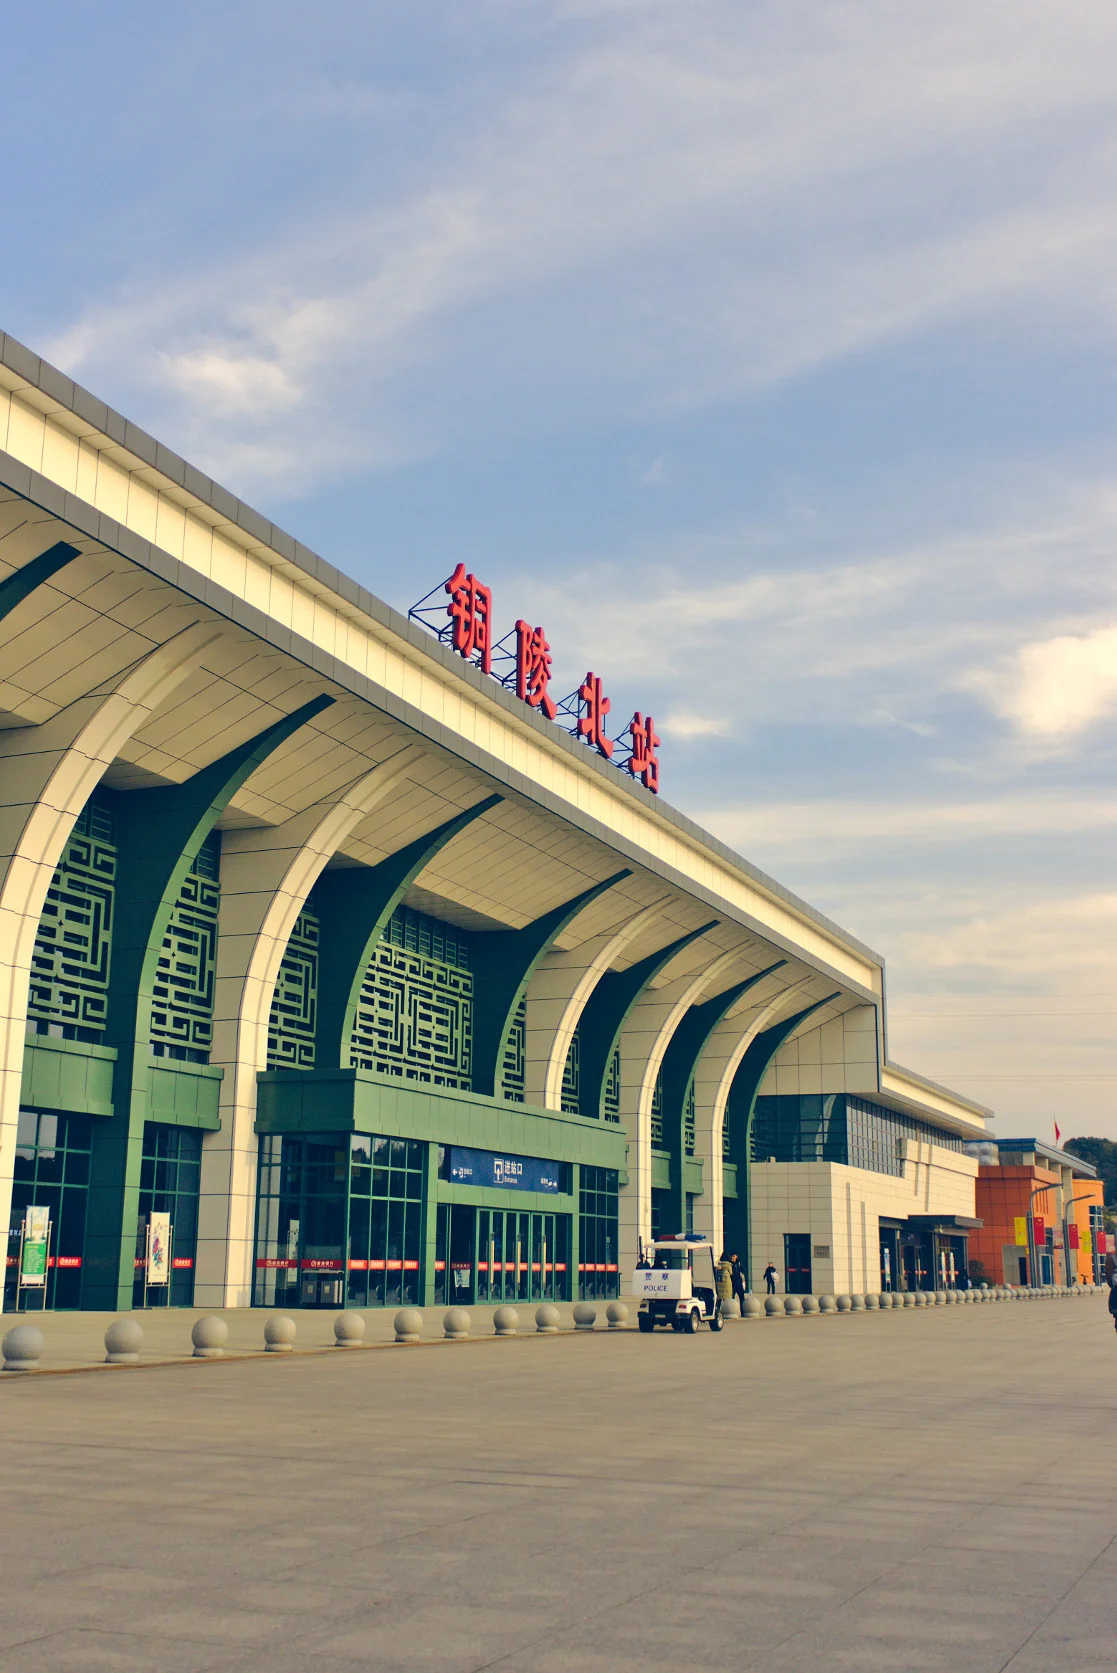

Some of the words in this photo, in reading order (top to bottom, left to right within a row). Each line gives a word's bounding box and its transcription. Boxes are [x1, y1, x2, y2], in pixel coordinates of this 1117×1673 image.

[444, 562, 661, 795] 铜陵北站
[504, 1160, 523, 1176] 进站口
[645, 1272, 669, 1281] 警察
[643, 1284, 668, 1292] POLICE
